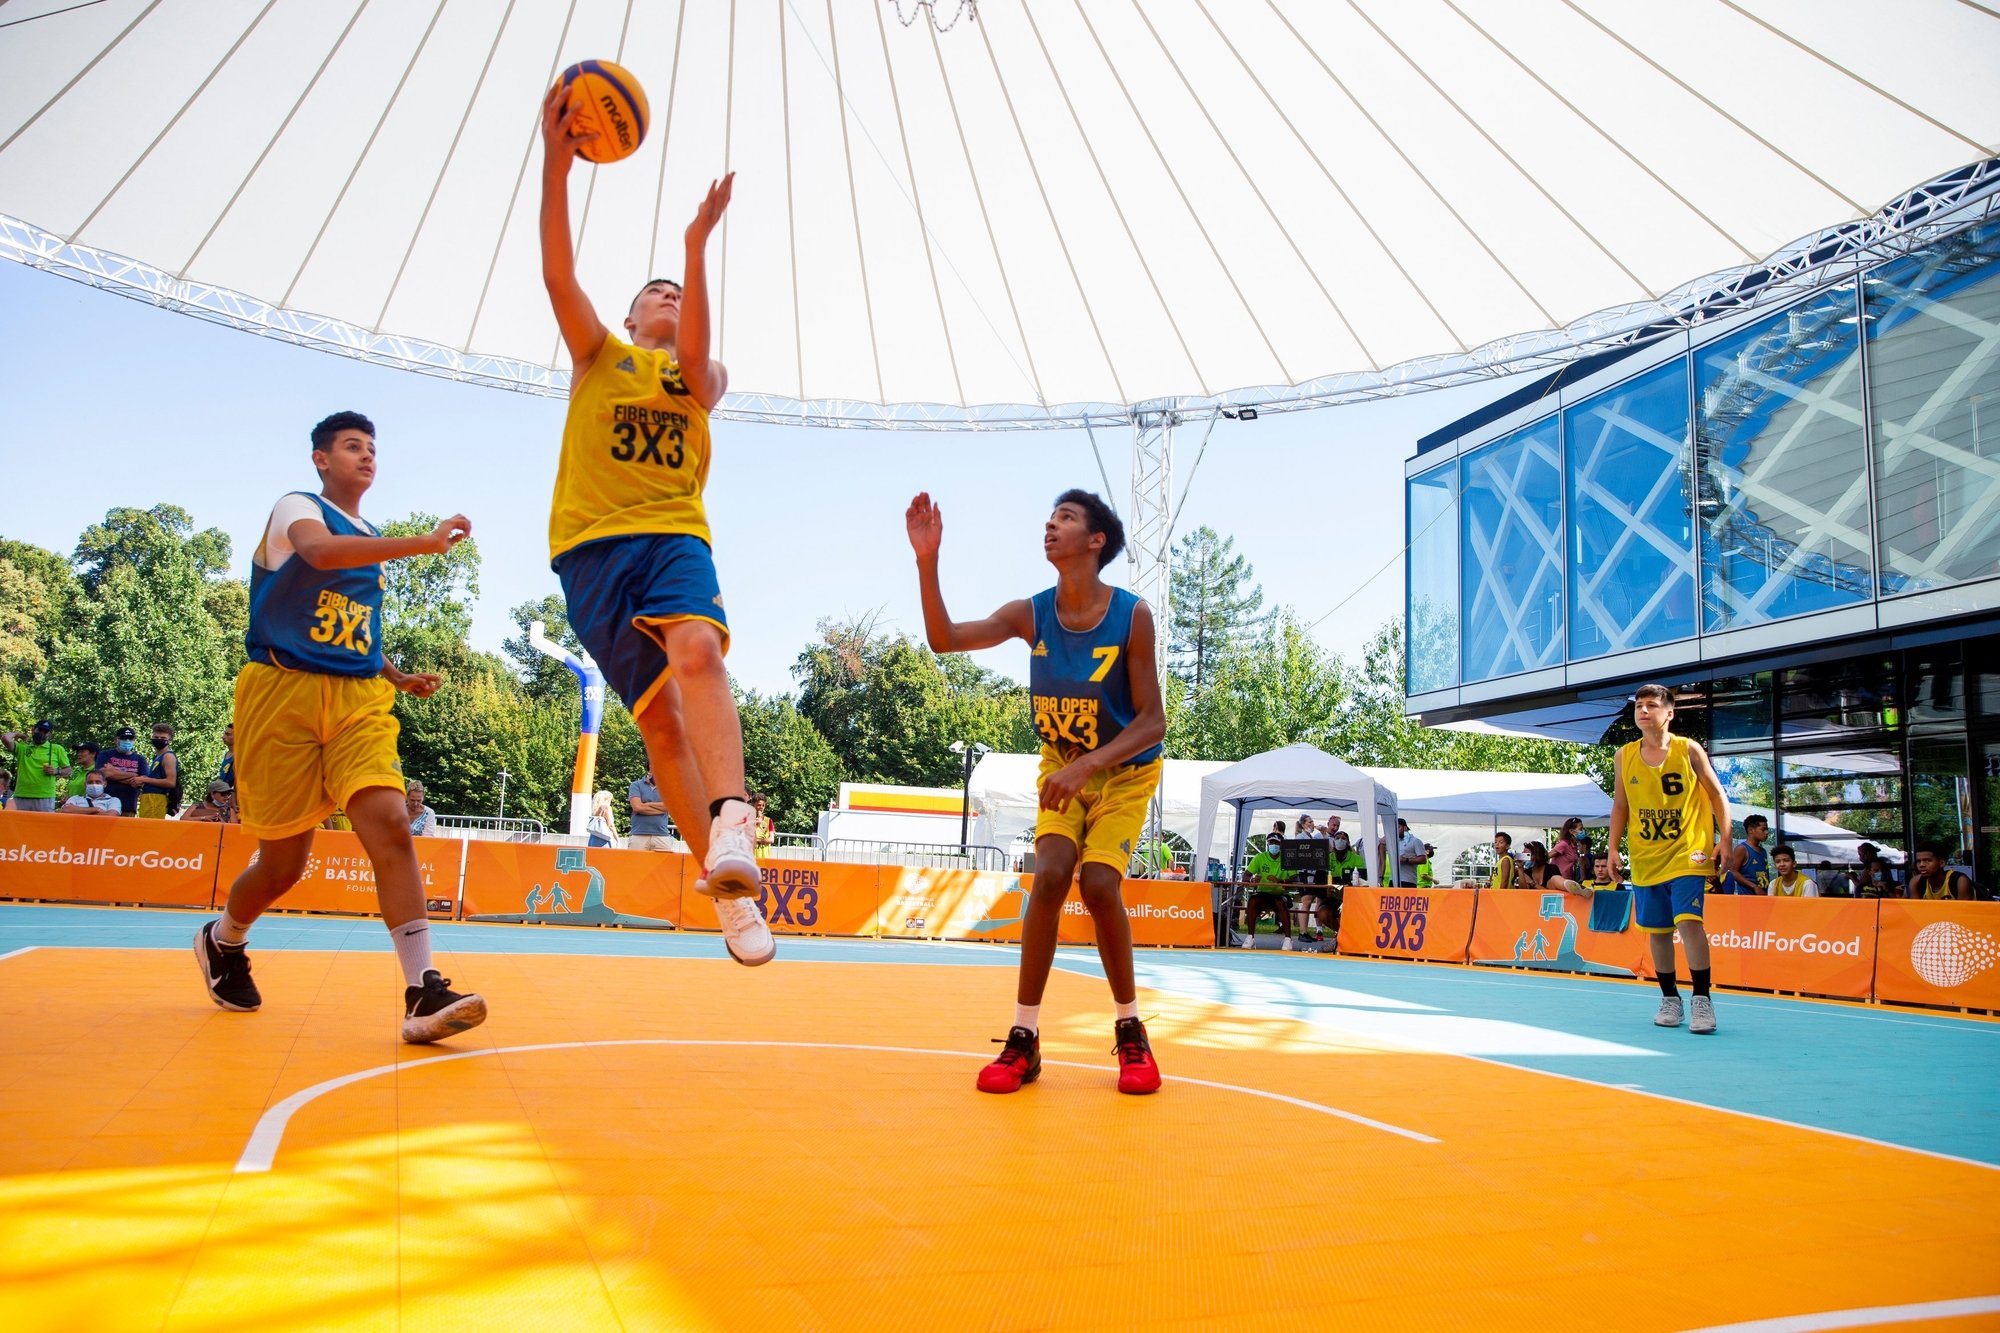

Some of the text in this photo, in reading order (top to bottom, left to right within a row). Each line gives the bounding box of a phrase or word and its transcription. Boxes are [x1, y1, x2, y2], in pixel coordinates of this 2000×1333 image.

[600, 95, 632, 152] molten
[614, 405, 688, 430] FIBA OPEN
[611, 421, 685, 469] 3X3
[318, 589, 373, 620] FIBA OPE
[310, 606, 373, 656] 3X3
[1088, 645, 1120, 683] 7
[1033, 695, 1098, 714] FIBA OPEN
[1034, 712, 1099, 750] 3X3
[1661, 772, 1684, 796] 6
[1639, 808, 1682, 818] FIBA OPEN
[1640, 819, 1682, 841] 3X3
[0, 844, 204, 871] asketballForGood
[760, 867, 819, 886] BA OPEN
[754, 884, 818, 927] 3X3
[1380, 895, 1430, 912] FIBA OPEN
[1376, 911, 1427, 951] 3X3
